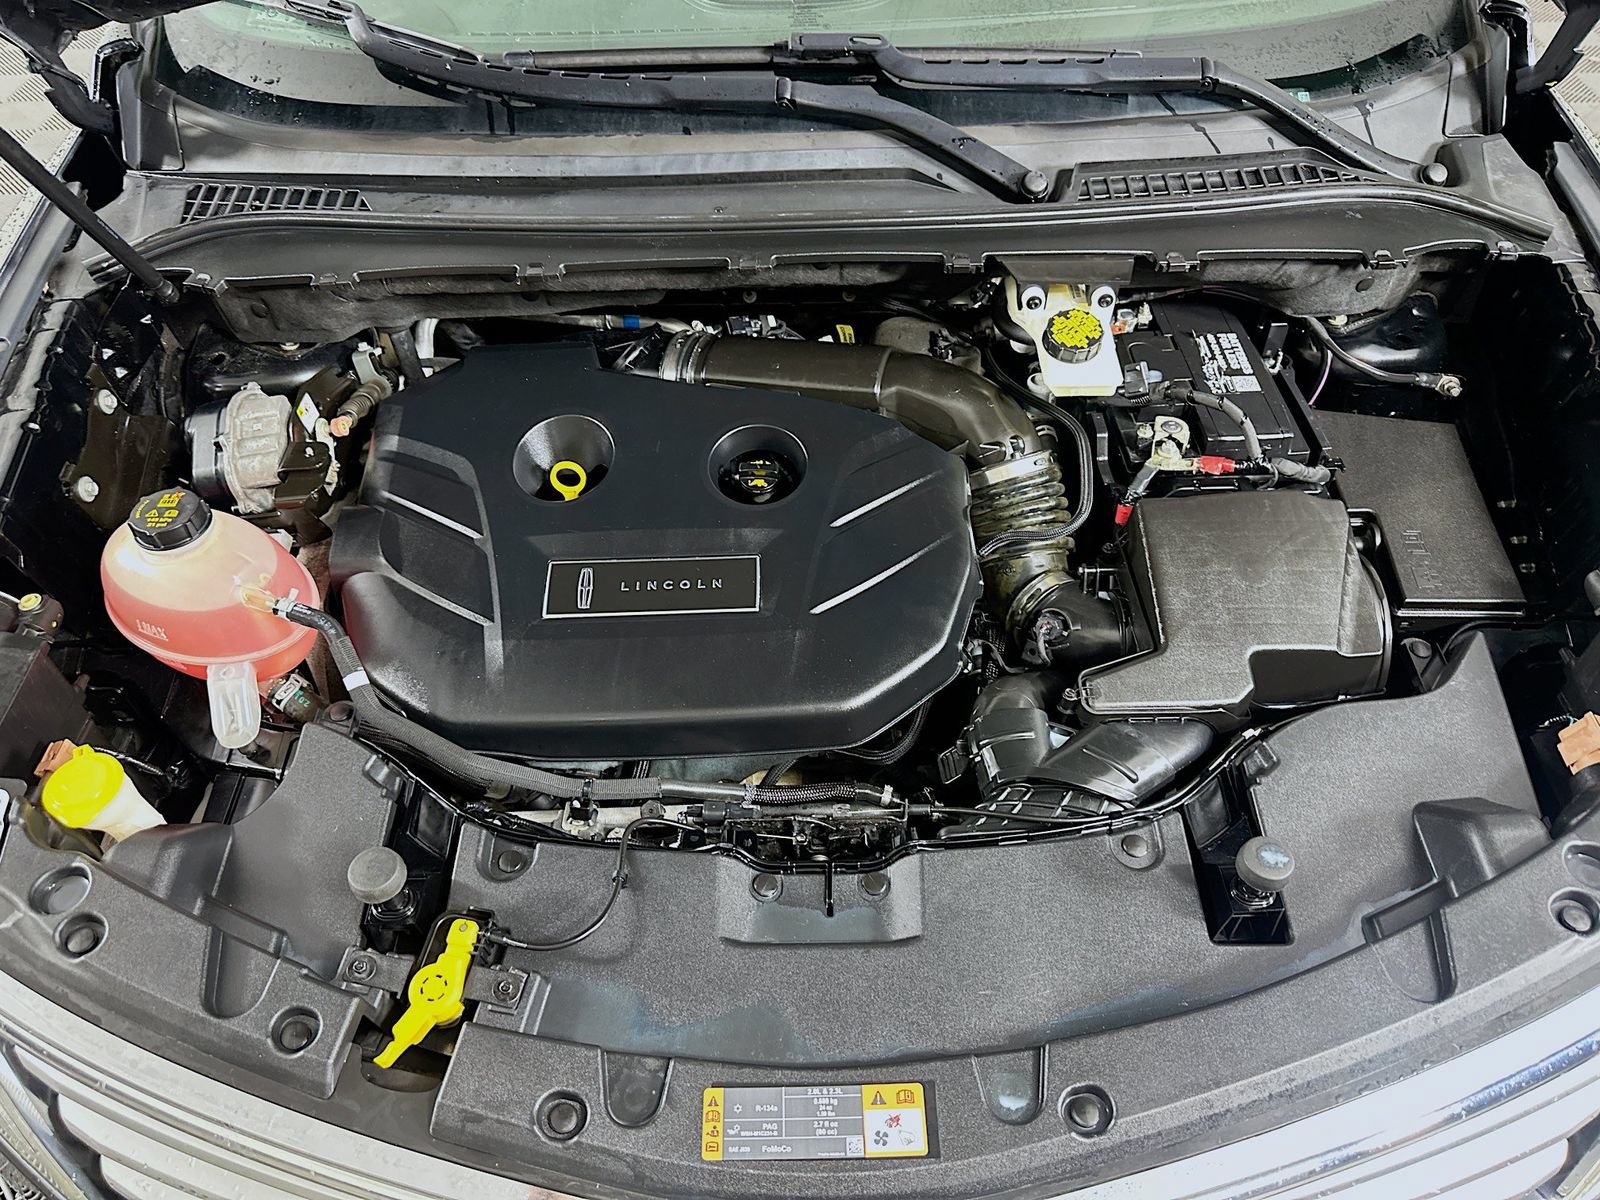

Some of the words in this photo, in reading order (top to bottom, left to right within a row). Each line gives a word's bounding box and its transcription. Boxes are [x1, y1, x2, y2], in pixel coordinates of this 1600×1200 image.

[1226, 333, 1254, 375] BATTERIES
[620, 578, 723, 591] LINCOLN
[755, 1104, 778, 1112] R-134a
[762, 1122, 778, 1130] PAG
[762, 1145, 792, 1153] FoMoCo
